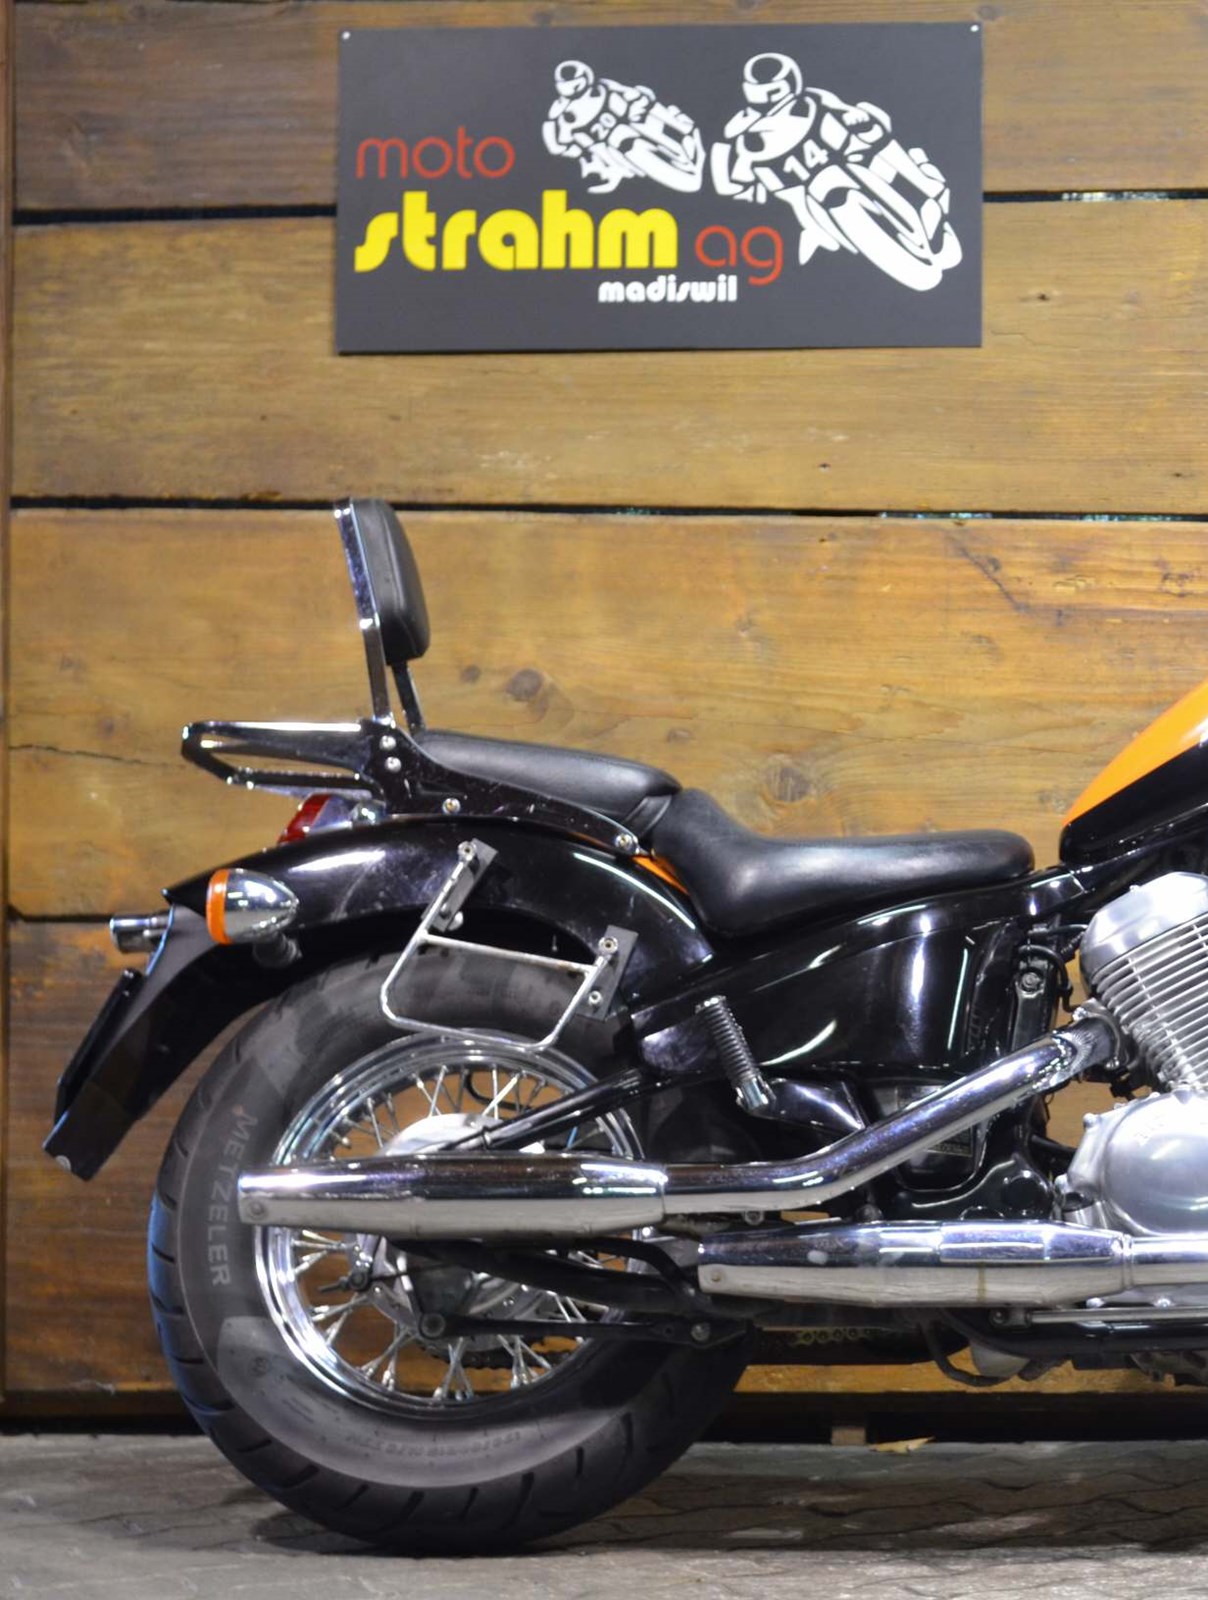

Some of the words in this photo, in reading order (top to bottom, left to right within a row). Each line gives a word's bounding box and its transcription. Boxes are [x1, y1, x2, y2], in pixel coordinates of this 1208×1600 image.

[355, 126, 515, 179] moto
[784, 139, 828, 181] 14
[354, 190, 678, 272] strahm
[695, 225, 784, 285] ag
[599, 273, 737, 303] madiswil
[207, 1111, 258, 1287] METZELER
